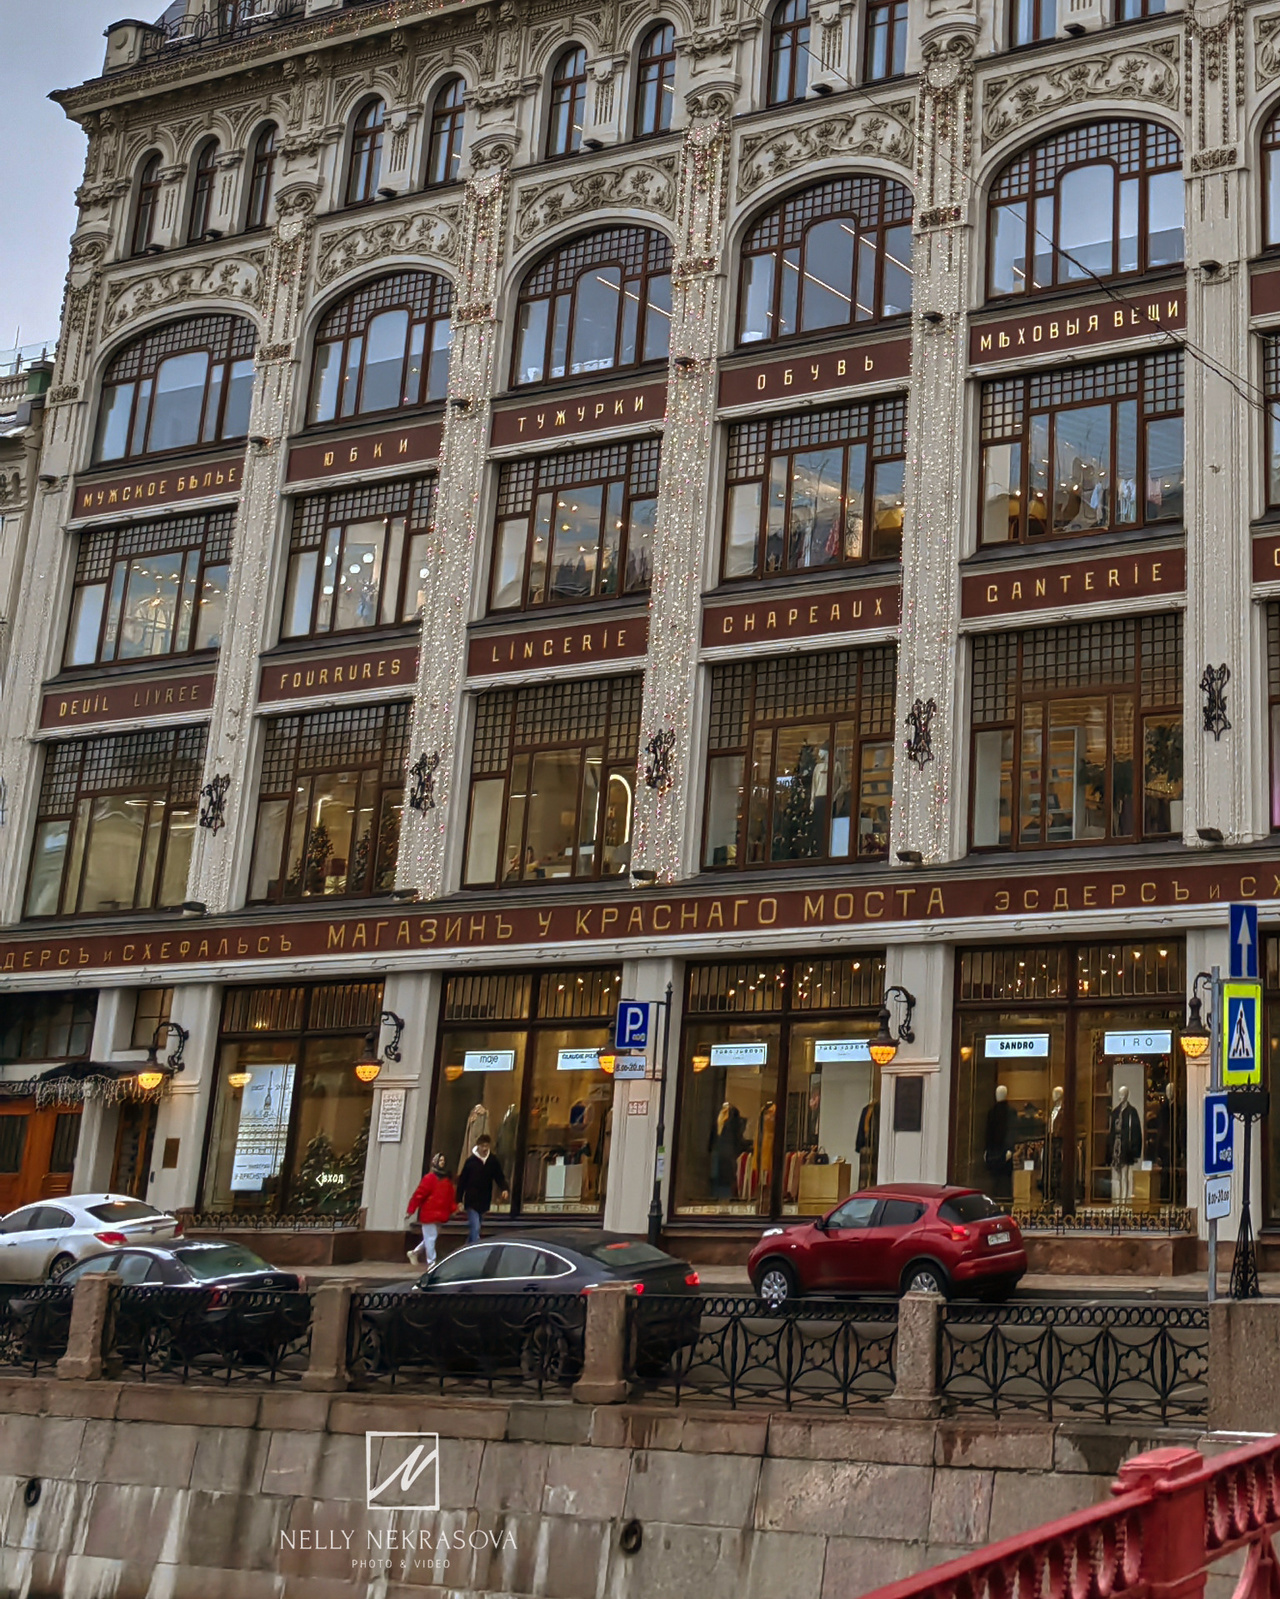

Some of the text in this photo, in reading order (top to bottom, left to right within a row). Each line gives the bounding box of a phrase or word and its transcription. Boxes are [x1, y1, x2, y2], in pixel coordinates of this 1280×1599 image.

[1113, 300, 1179, 328] ВЕЩИ
[756, 355, 875, 391] ОБУВЬ
[517, 394, 645, 433] ТУЖУРКИ
[323, 437, 410, 467] ЮБКИ
[83, 480, 168, 507] МУЖСКОЕ
[986, 562, 1163, 603] GANTERIE
[722, 597, 884, 634] CHAPEAUX
[491, 628, 627, 663] LINGERIE
[280, 658, 402, 690] FOURRURES
[59, 693, 110, 718] DEUIL
[0, 947, 90, 971] ДЕРСЪ
[122, 933, 293, 963] СХЕФАЛЬСЪ
[327, 913, 514, 949] МАГАЗИНЪ
[537, 911, 554, 938] У
[575, 897, 778, 936] КРАСНАГО
[803, 887, 946, 921] МОСТА
[994, 880, 1190, 912] ЭСДЕРСЪ
[999, 1041, 1034, 1050] SANDRO
[1122, 1037, 1153, 1047] IRO
